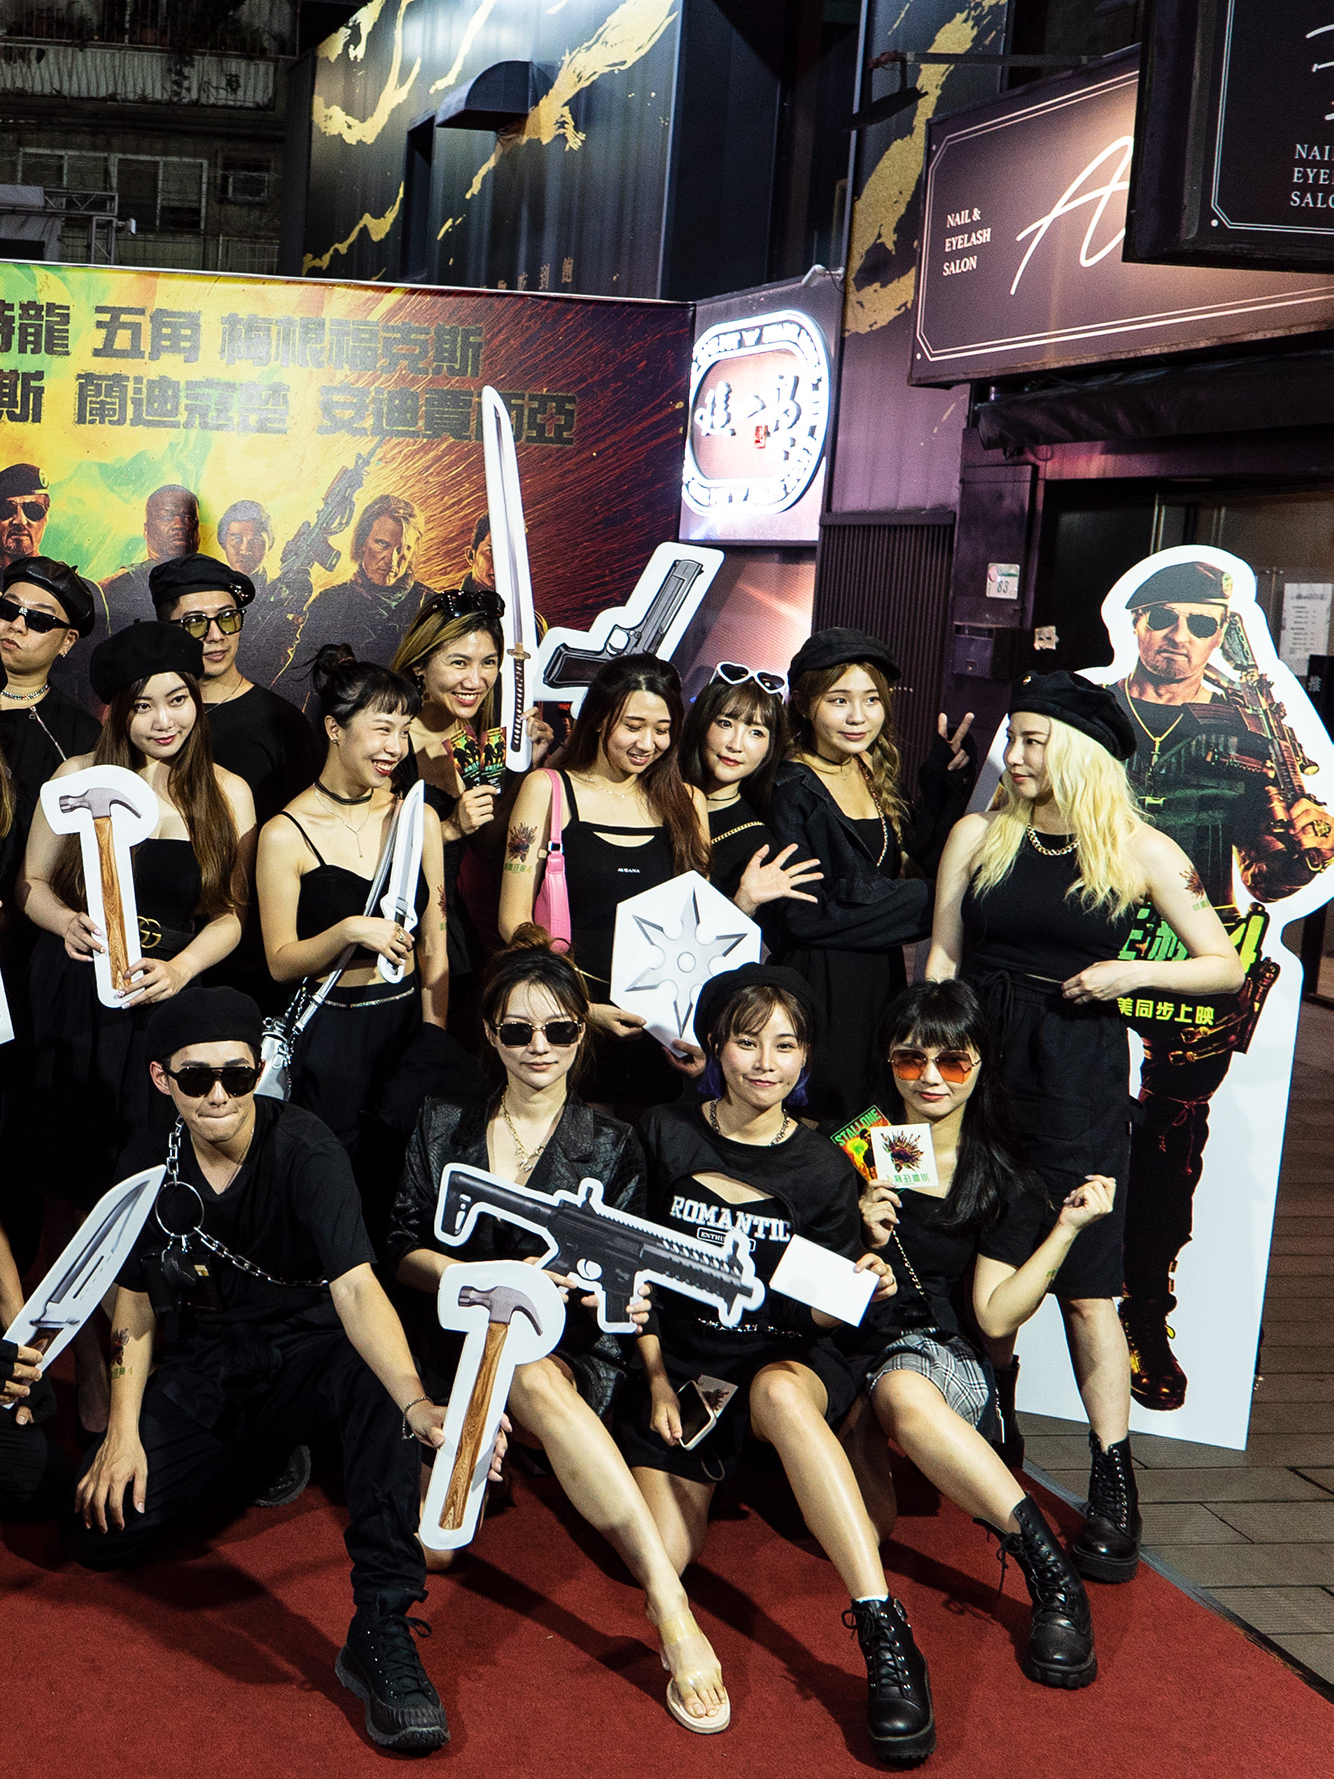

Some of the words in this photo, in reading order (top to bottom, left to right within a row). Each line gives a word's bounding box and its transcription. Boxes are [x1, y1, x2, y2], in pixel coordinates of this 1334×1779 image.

[1293, 143, 1334, 161] NAI
[1291, 167, 1334, 185] EYE
[945, 209, 970, 228] NAIL
[971, 206, 982, 222] &
[944, 227, 992, 252] EYELASH
[941, 255, 978, 277] SALON
[91, 304, 202, 363] 五角
[834, 1107, 883, 1147] STALLONE
